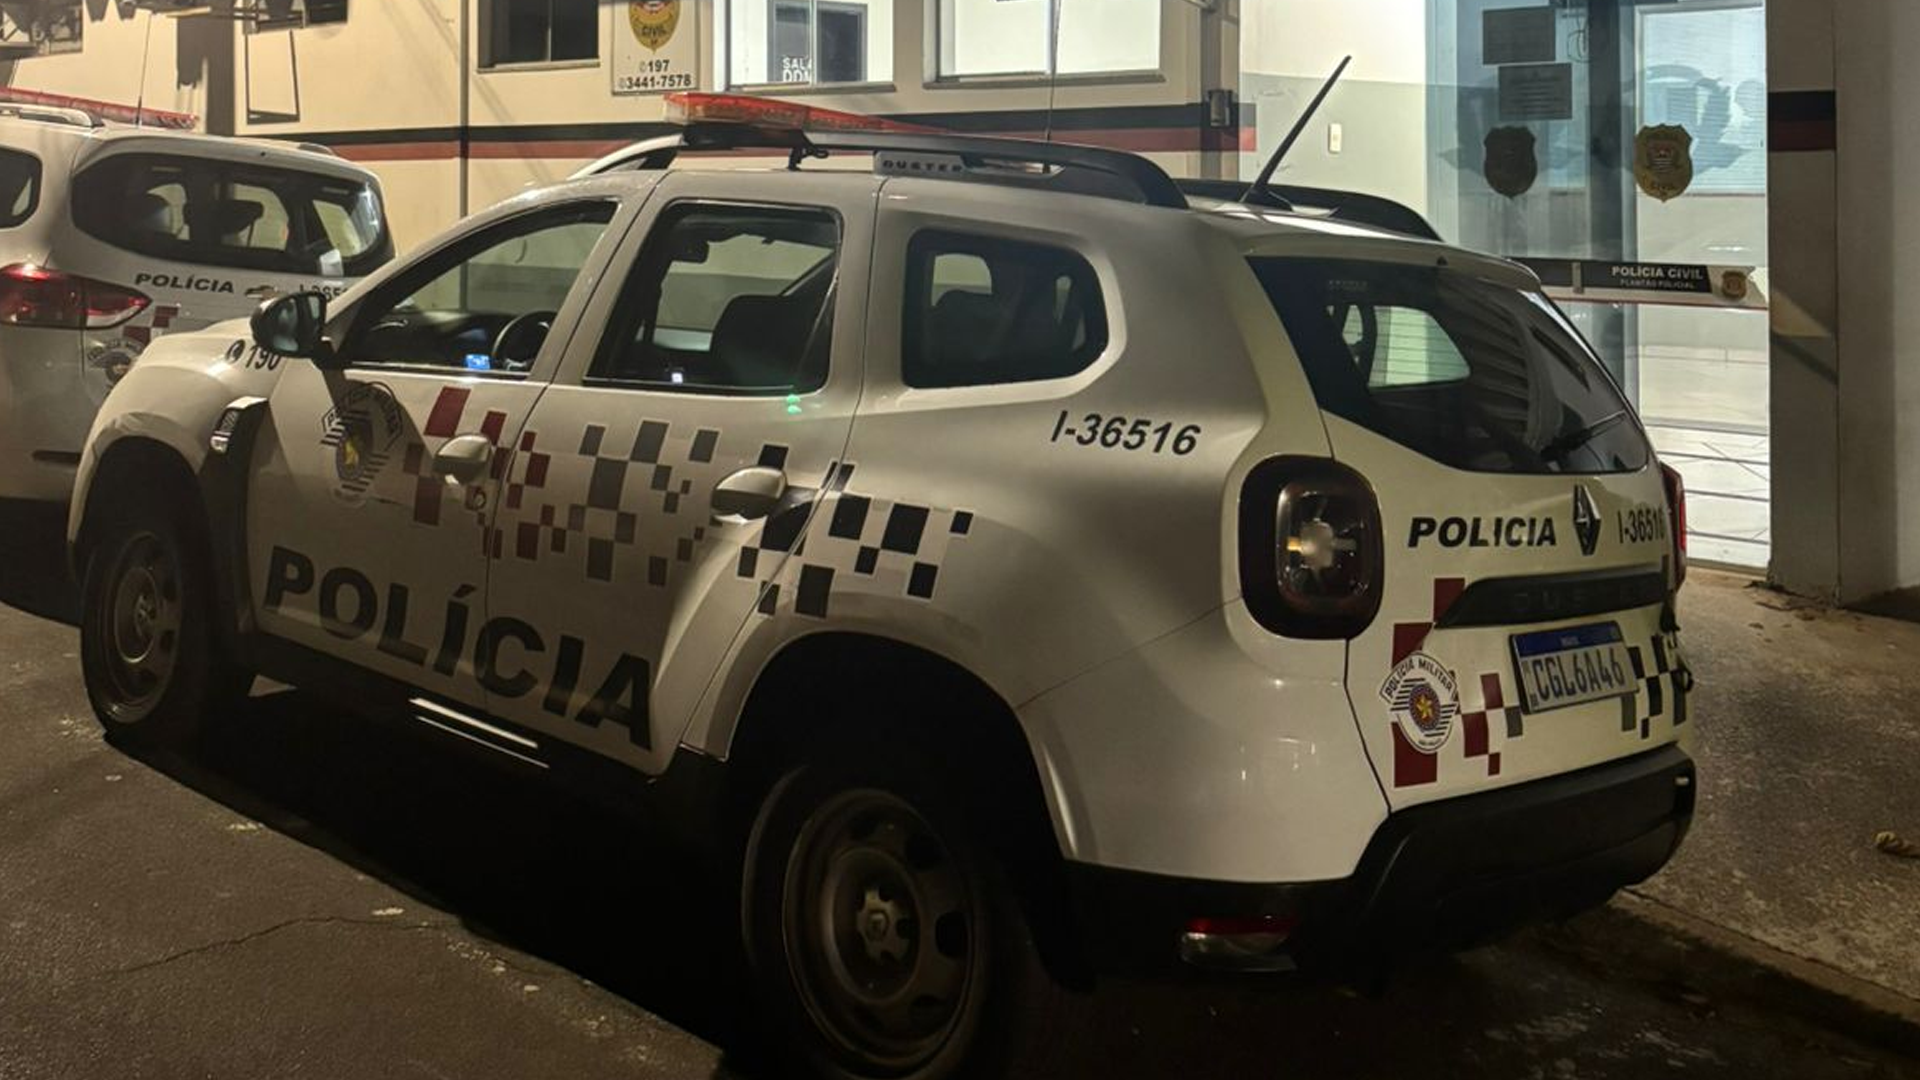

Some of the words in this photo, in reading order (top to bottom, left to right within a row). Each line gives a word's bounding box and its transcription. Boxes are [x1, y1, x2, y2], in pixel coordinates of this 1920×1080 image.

[648, 59, 670, 73] 197
[625, 73, 692, 89] 3441-7578
[135, 273, 234, 294] POLÍCIA
[1667, 267, 1704, 280] CIVIL
[245, 344, 283, 371] 190
[1050, 410, 1202, 455] I-36516
[1407, 516, 1557, 548] POLICIA
[263, 545, 653, 752] POLÍCIA
[1418, 658, 1453, 692] MILITAR
[1532, 646, 1626, 701] CGL6A46
